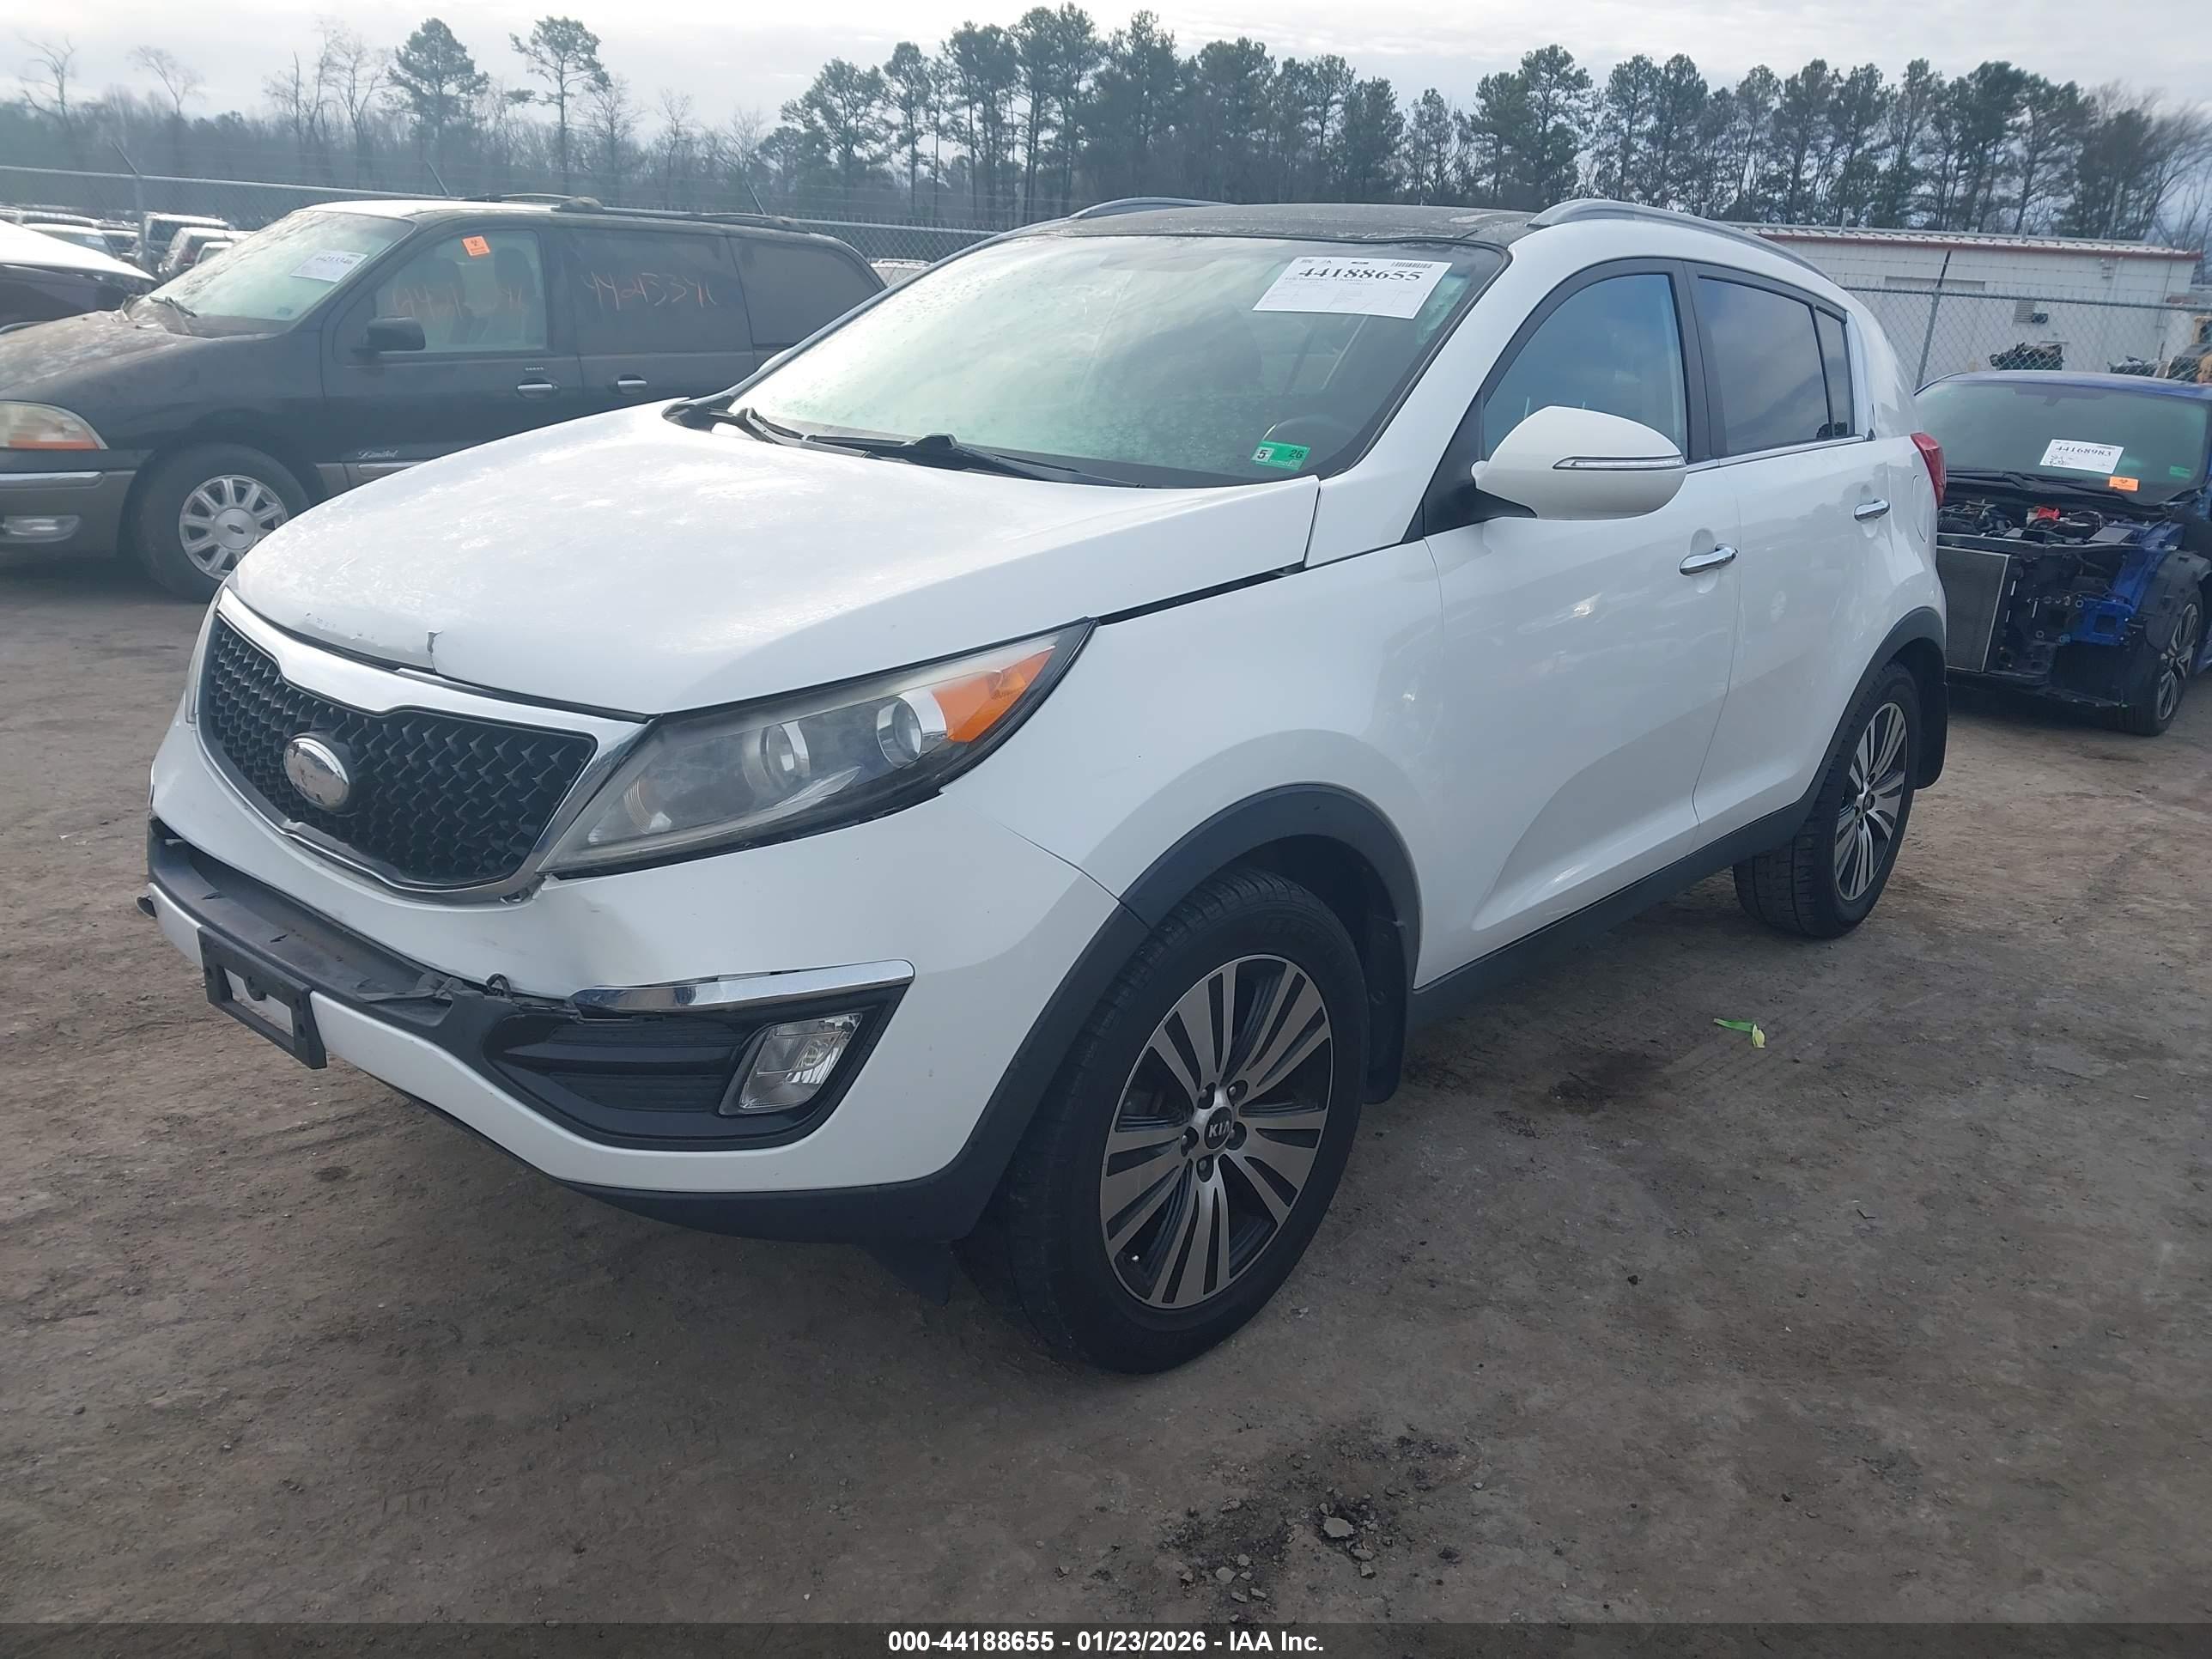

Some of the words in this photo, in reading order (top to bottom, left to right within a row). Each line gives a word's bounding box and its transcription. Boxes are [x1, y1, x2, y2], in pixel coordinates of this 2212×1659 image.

[1298, 267, 1423, 281] 44188655
[1257, 449, 1268, 459] 5
[1289, 449, 1304, 459] 26
[2055, 446, 2112, 457] 44168983
[1208, 1120, 1231, 1138] KIA
